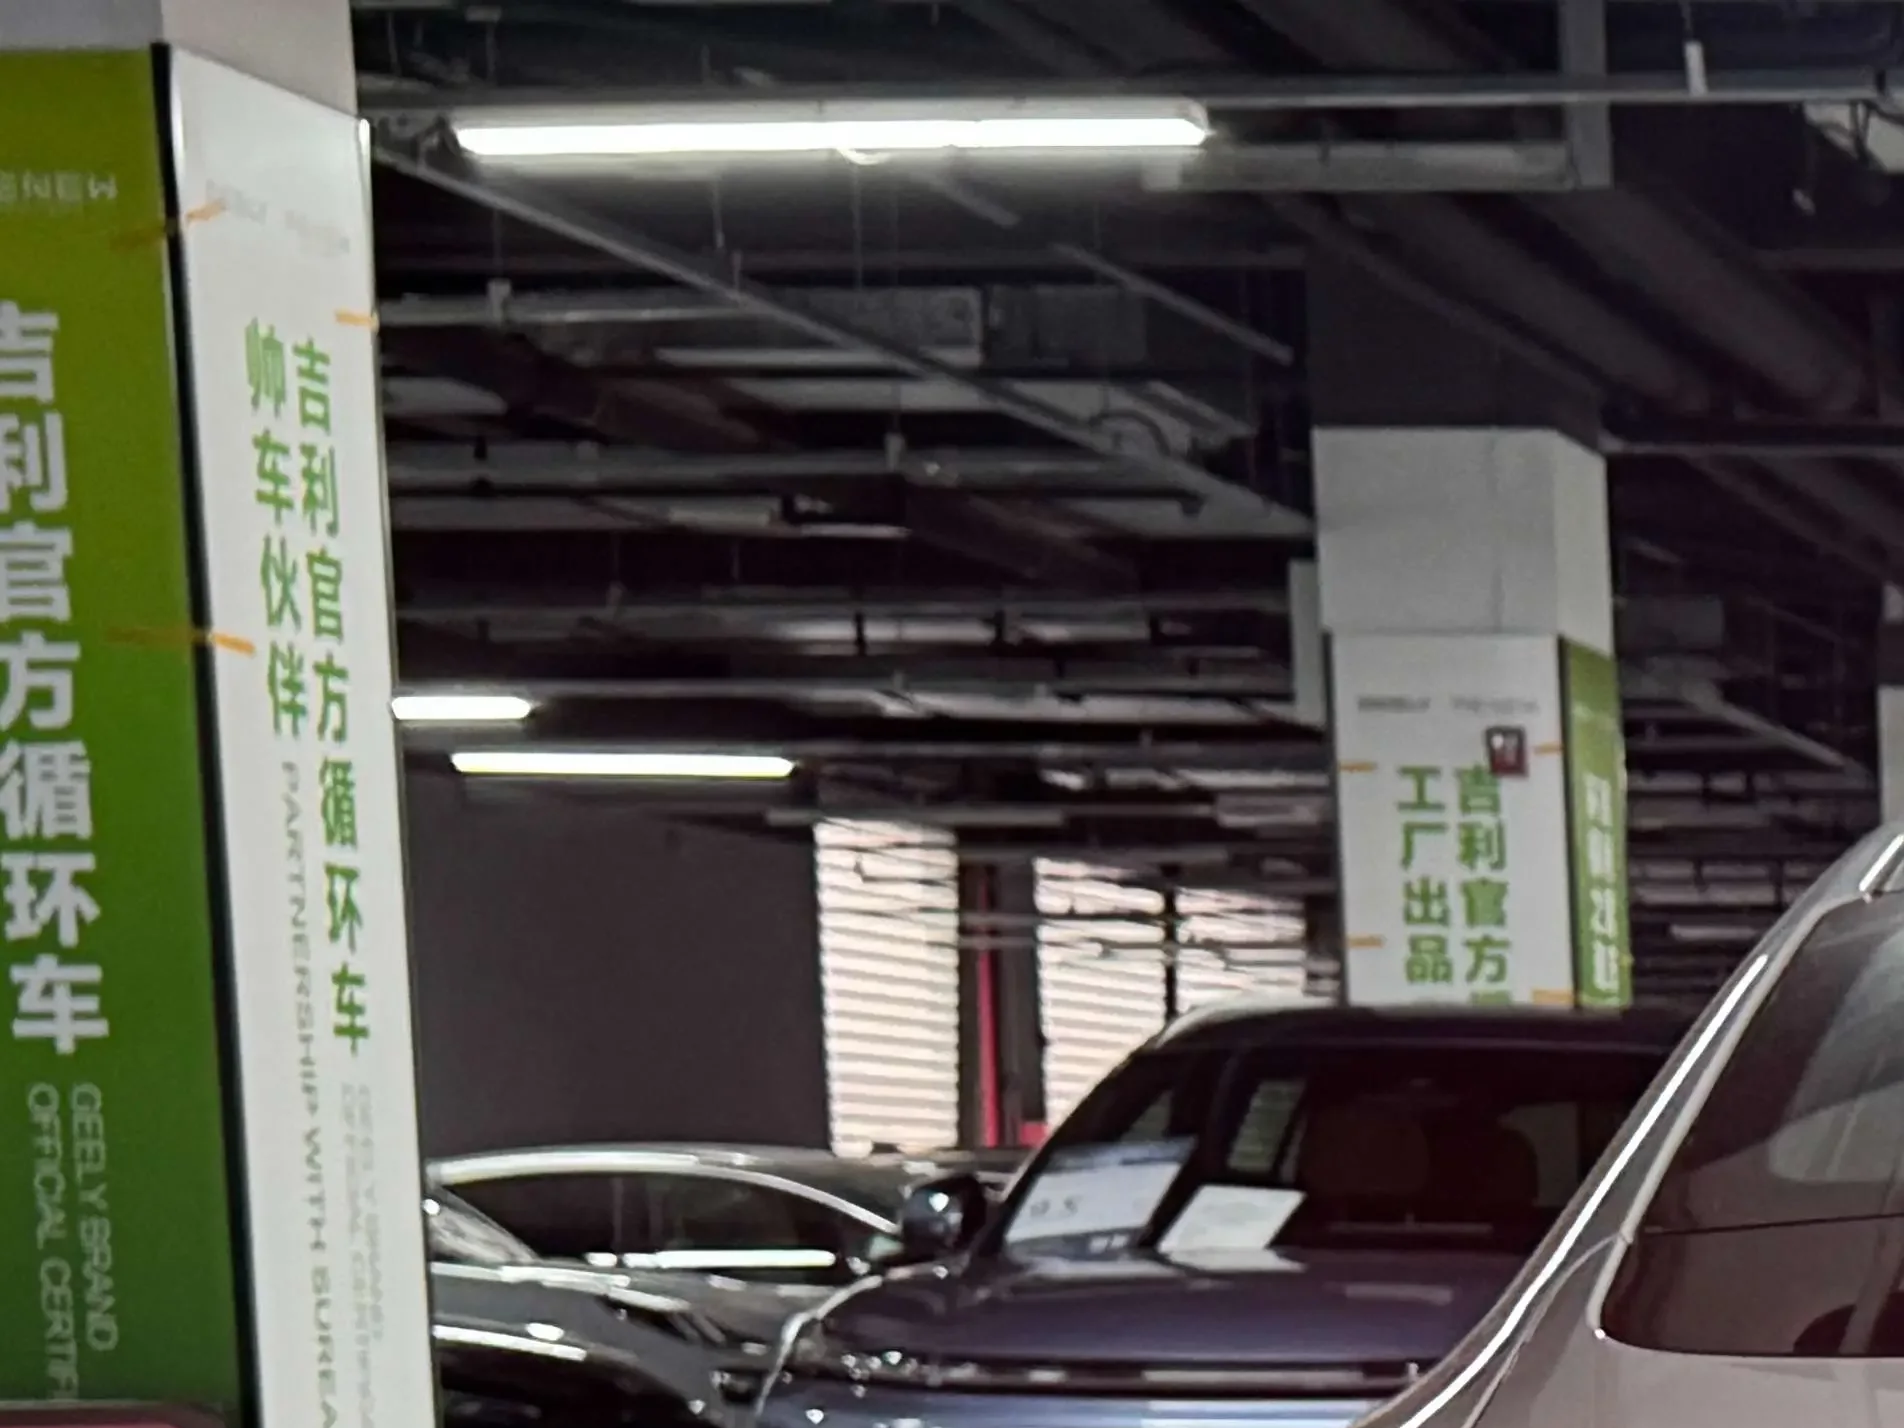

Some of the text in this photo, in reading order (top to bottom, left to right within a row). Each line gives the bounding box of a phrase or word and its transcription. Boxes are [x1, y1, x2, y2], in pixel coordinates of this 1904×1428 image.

[244, 319, 306, 740] 帅车伙伴
[292, 338, 370, 1055] 吉利官方循环车
[1397, 766, 1453, 985] 工厂出品
[1456, 763, 1515, 1006] 吉利官方
